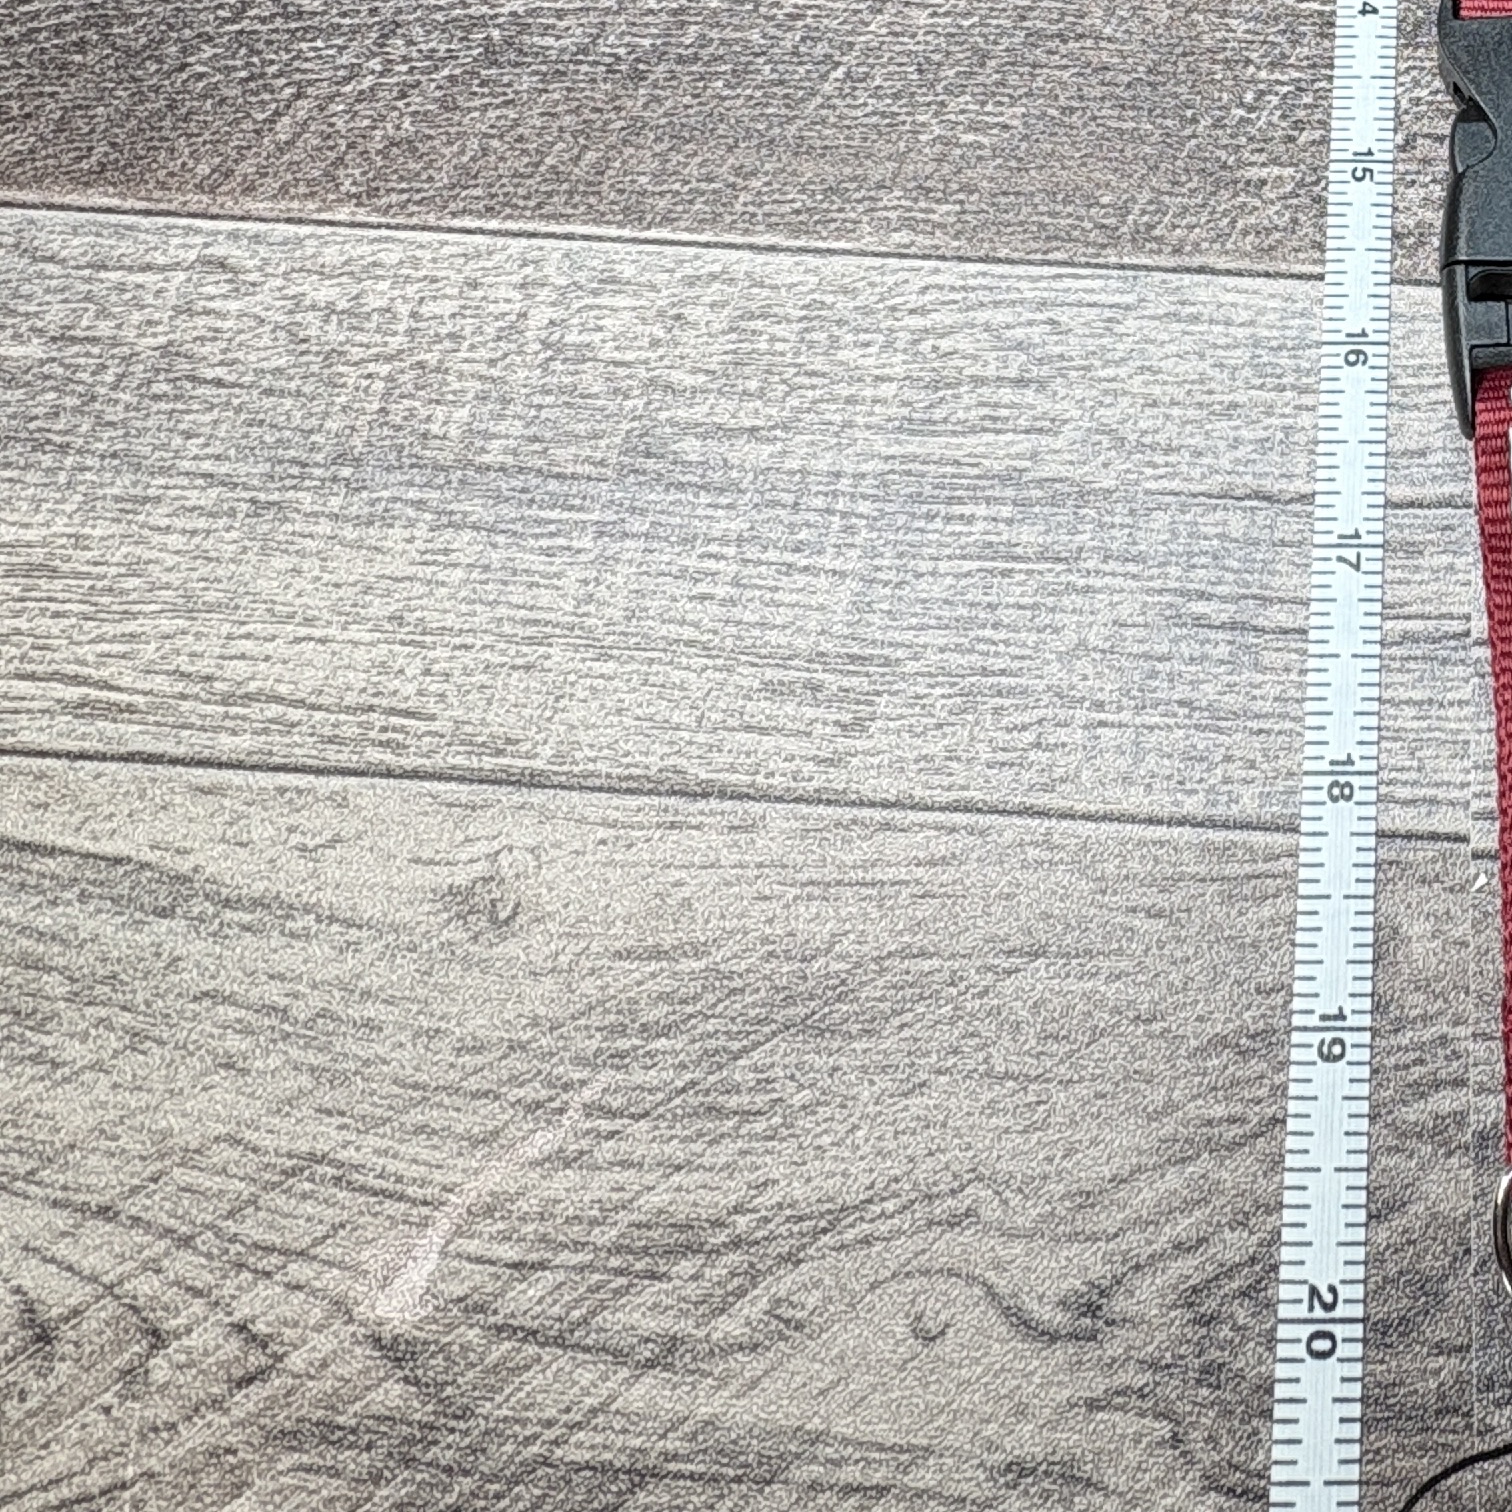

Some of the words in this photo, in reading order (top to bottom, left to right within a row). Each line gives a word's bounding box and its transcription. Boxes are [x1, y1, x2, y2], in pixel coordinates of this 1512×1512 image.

[1351, 146, 1376, 183] 15
[1343, 327, 1370, 368] 16
[1335, 527, 1363, 573] 17
[1327, 752, 1356, 804] 18
[1317, 1004, 1348, 1064] 19
[1305, 1282, 1339, 1361] 20
